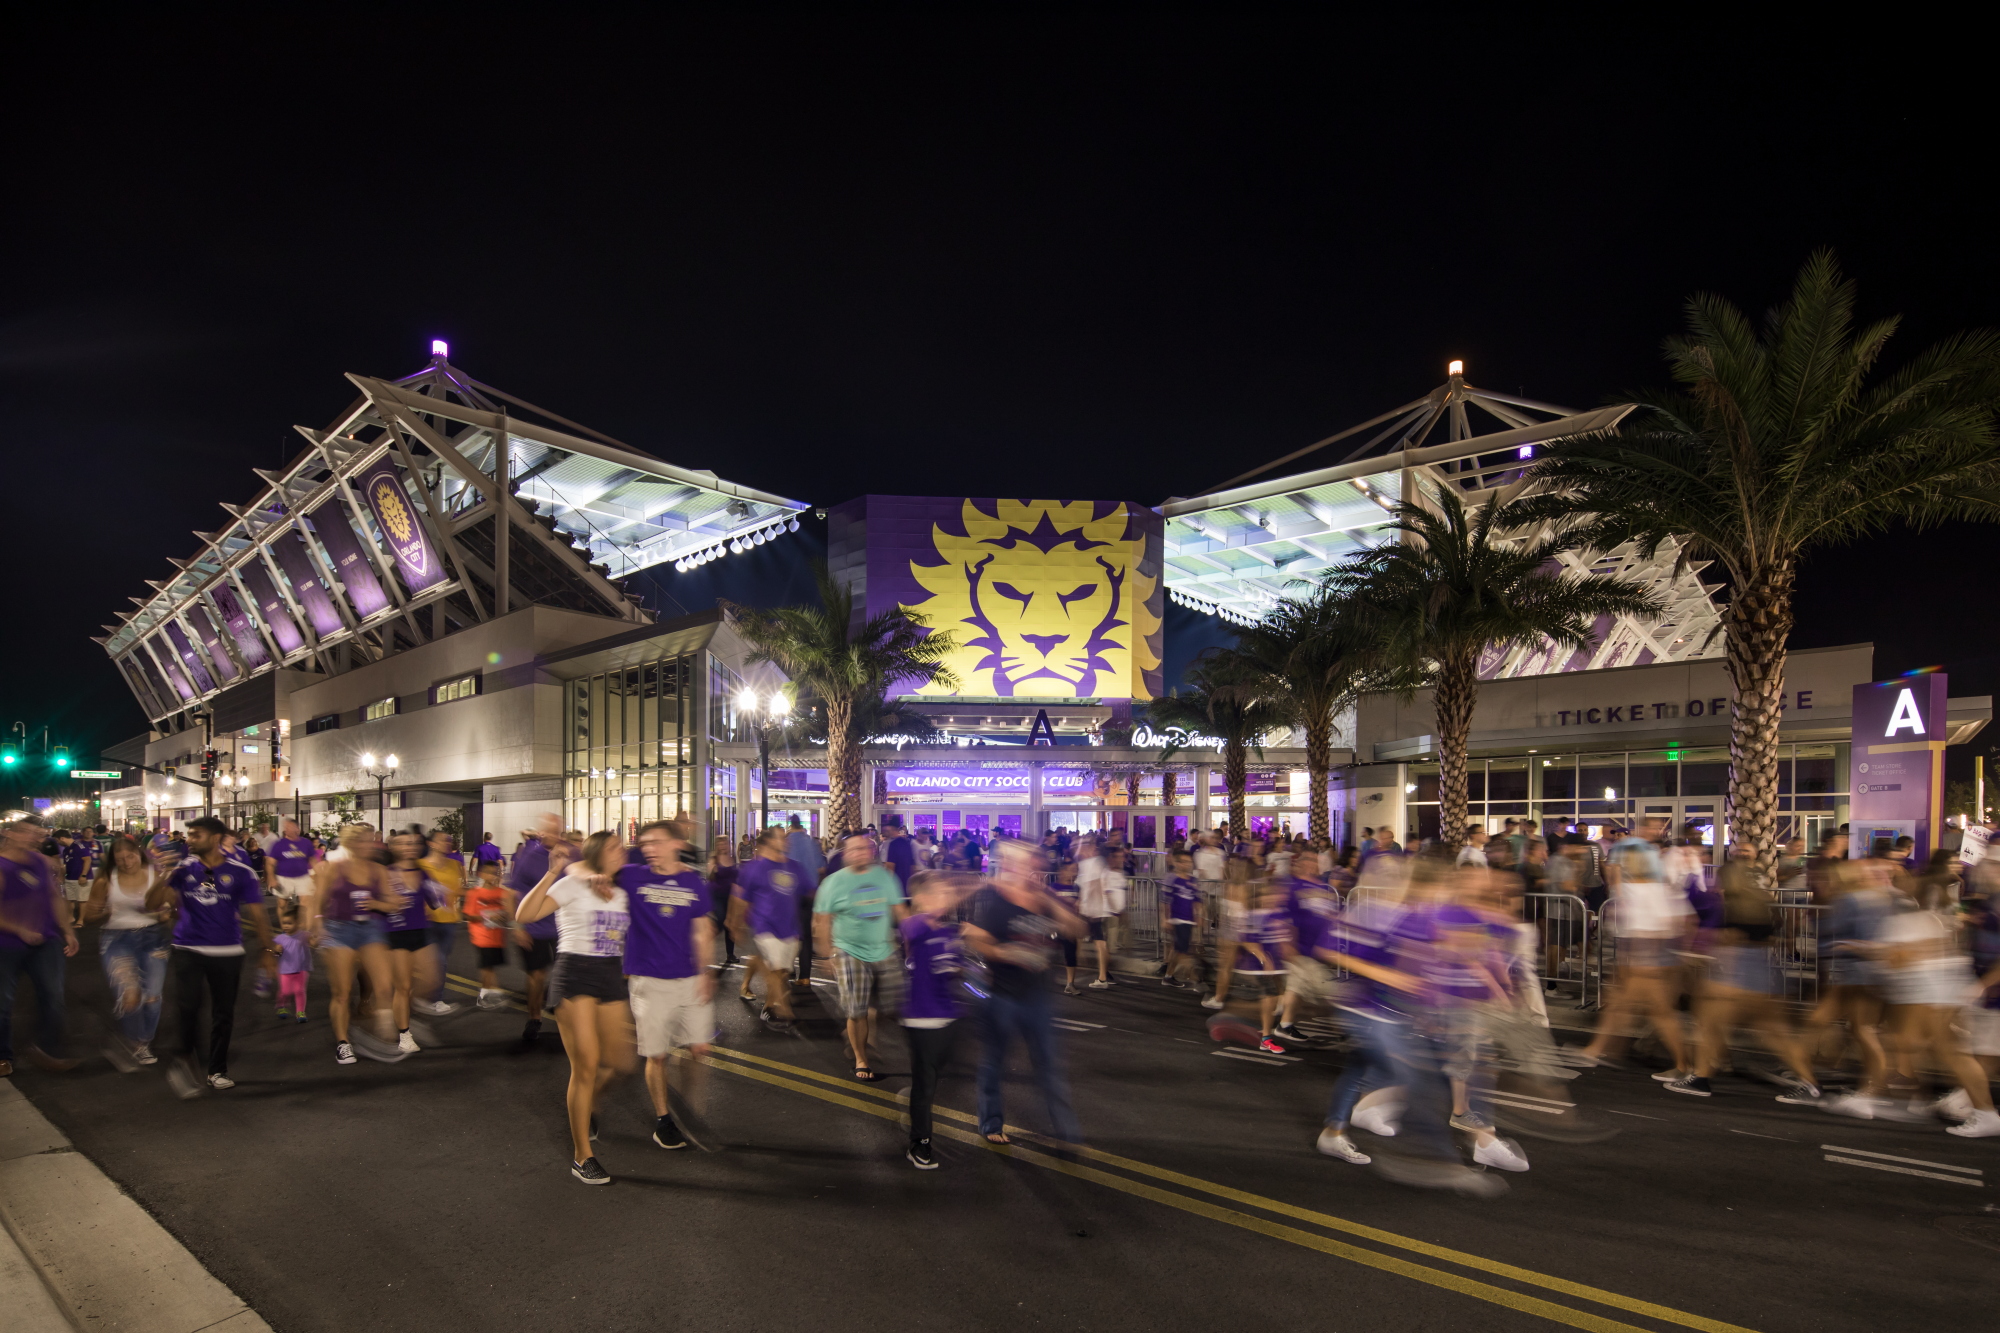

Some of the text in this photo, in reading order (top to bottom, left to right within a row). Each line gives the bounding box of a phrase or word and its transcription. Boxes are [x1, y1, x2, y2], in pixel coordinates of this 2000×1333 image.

[401, 540, 422, 557] ORLANDO
[410, 551, 421, 563] CITY
[1557, 690, 1813, 727] TICKET OFE
[1884, 687, 1926, 738] A
[1026, 708, 1058, 746] A
[895, 776, 1084, 787] ORLANDO CITY SOCCR CLUB
